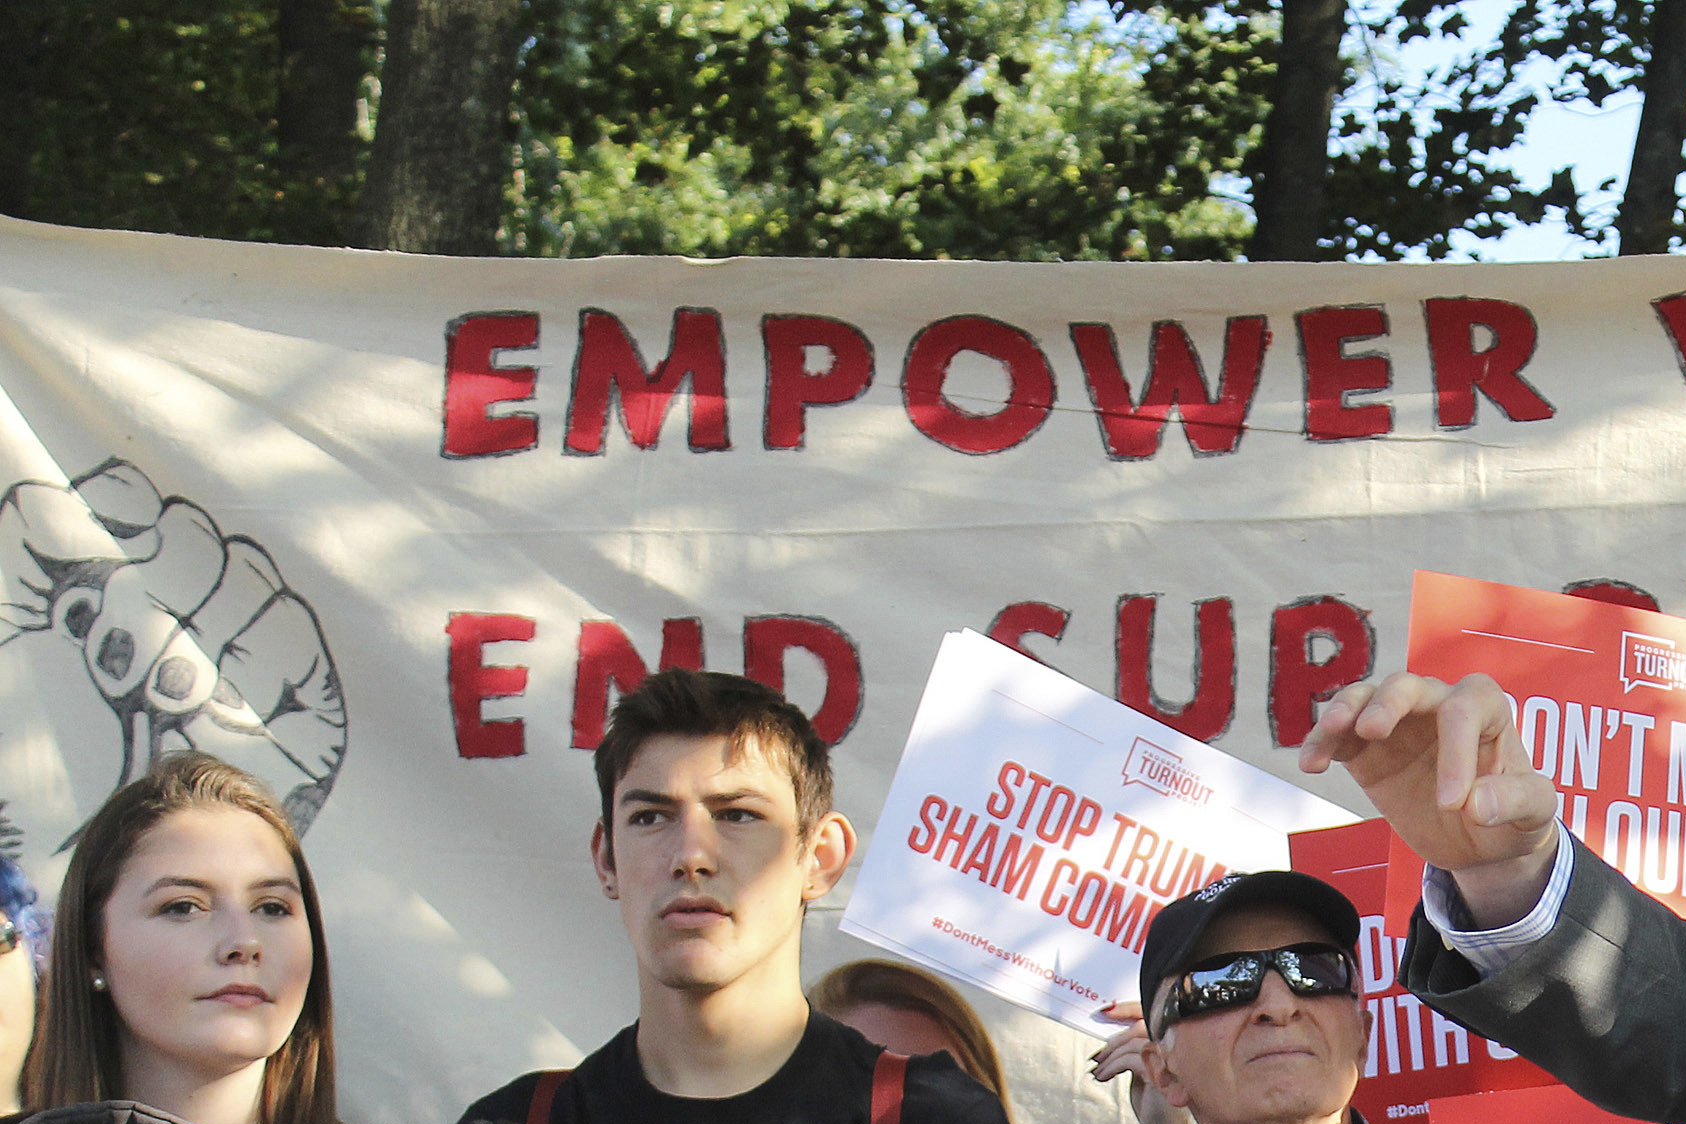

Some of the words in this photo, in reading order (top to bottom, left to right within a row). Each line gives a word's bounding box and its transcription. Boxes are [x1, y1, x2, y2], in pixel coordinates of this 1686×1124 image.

[441, 296, 1557, 462] EMPOWER
[447, 612, 864, 761] END
[1139, 754, 1215, 805] TURNOUT
[1503, 691, 1656, 797] ON'T
[908, 794, 1046, 902] SHAM
[986, 760, 1103, 852] STOP
[1102, 812, 1236, 899] TRUM
[931, 915, 1099, 1003] #DontMessWithOurVote
